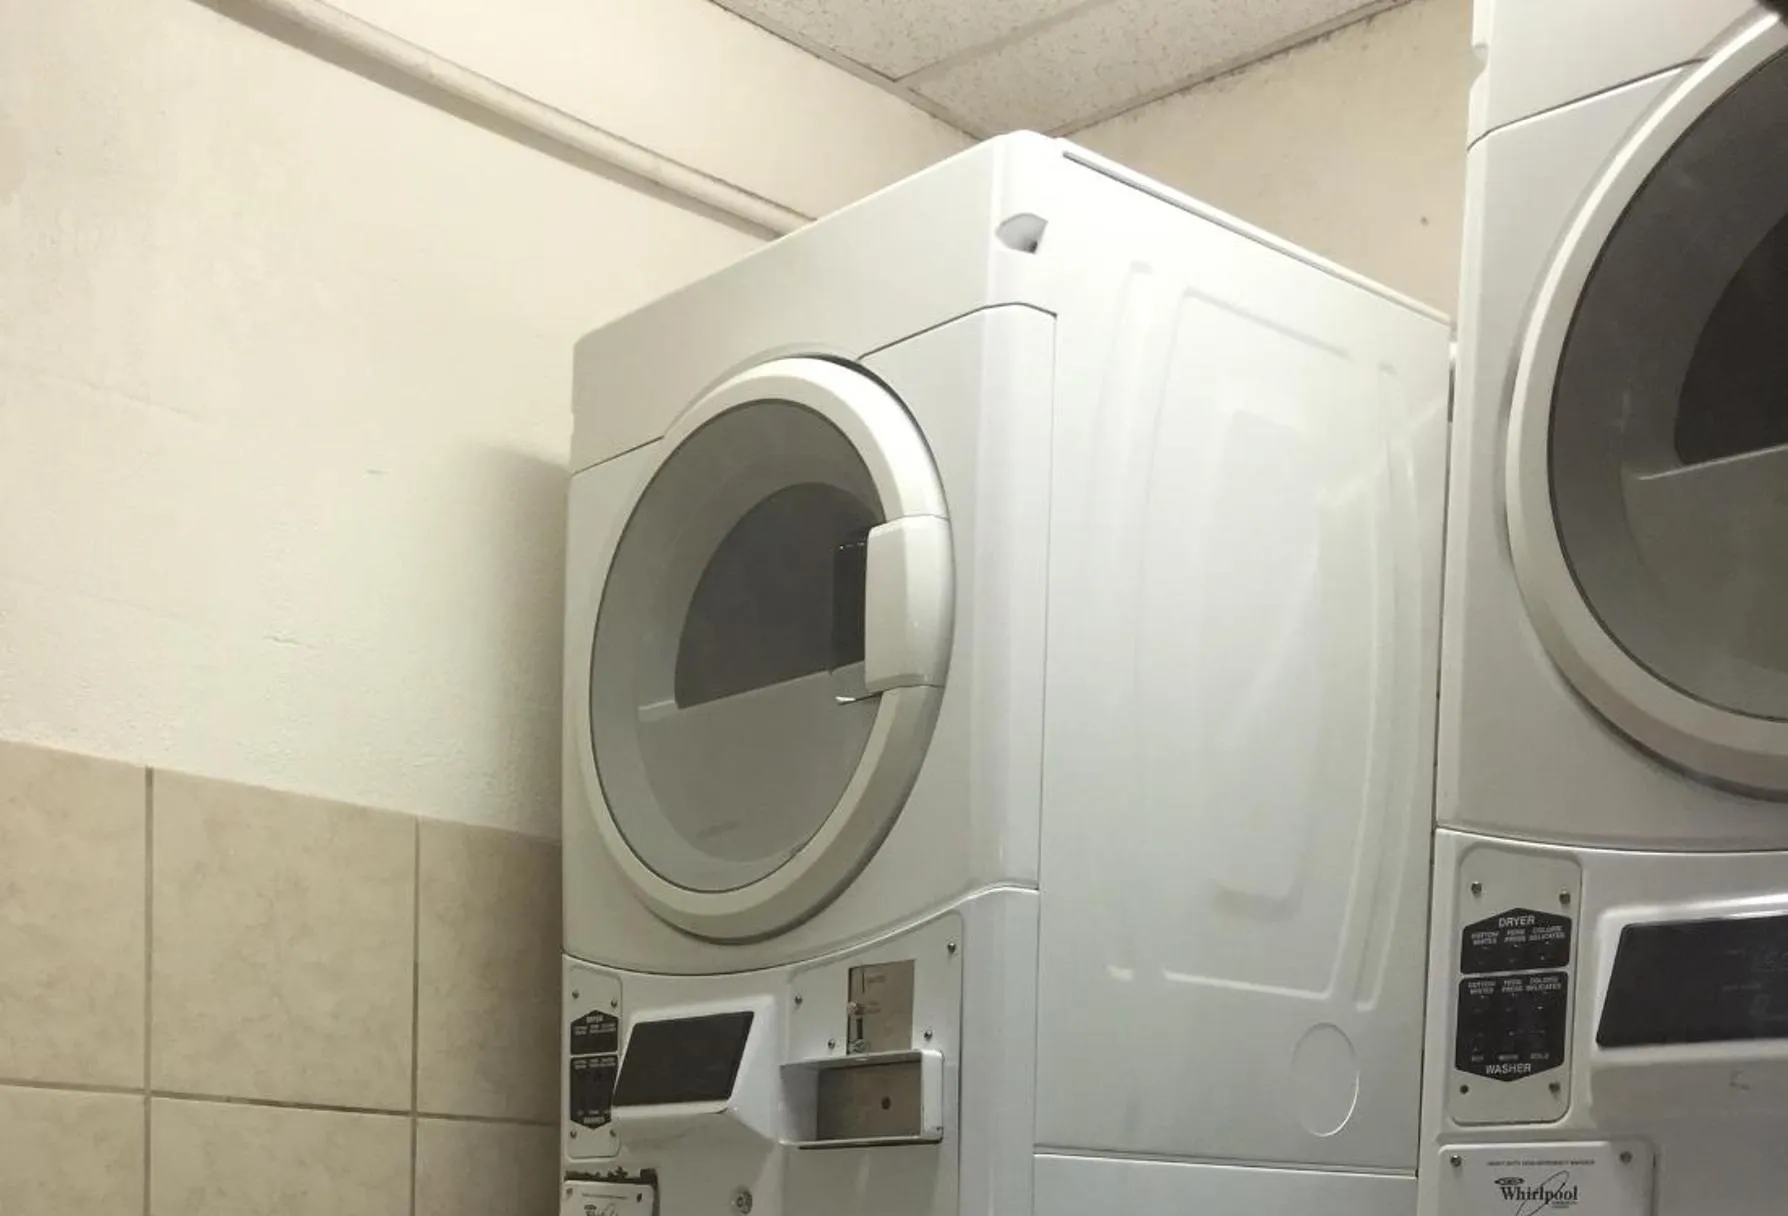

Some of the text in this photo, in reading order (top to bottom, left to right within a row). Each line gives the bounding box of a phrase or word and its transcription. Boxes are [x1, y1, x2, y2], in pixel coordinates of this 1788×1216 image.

[1498, 915, 1535, 928] DRYER
[1485, 1063, 1532, 1075] WASHER
[1499, 1185, 1578, 1205] Whirlpool
